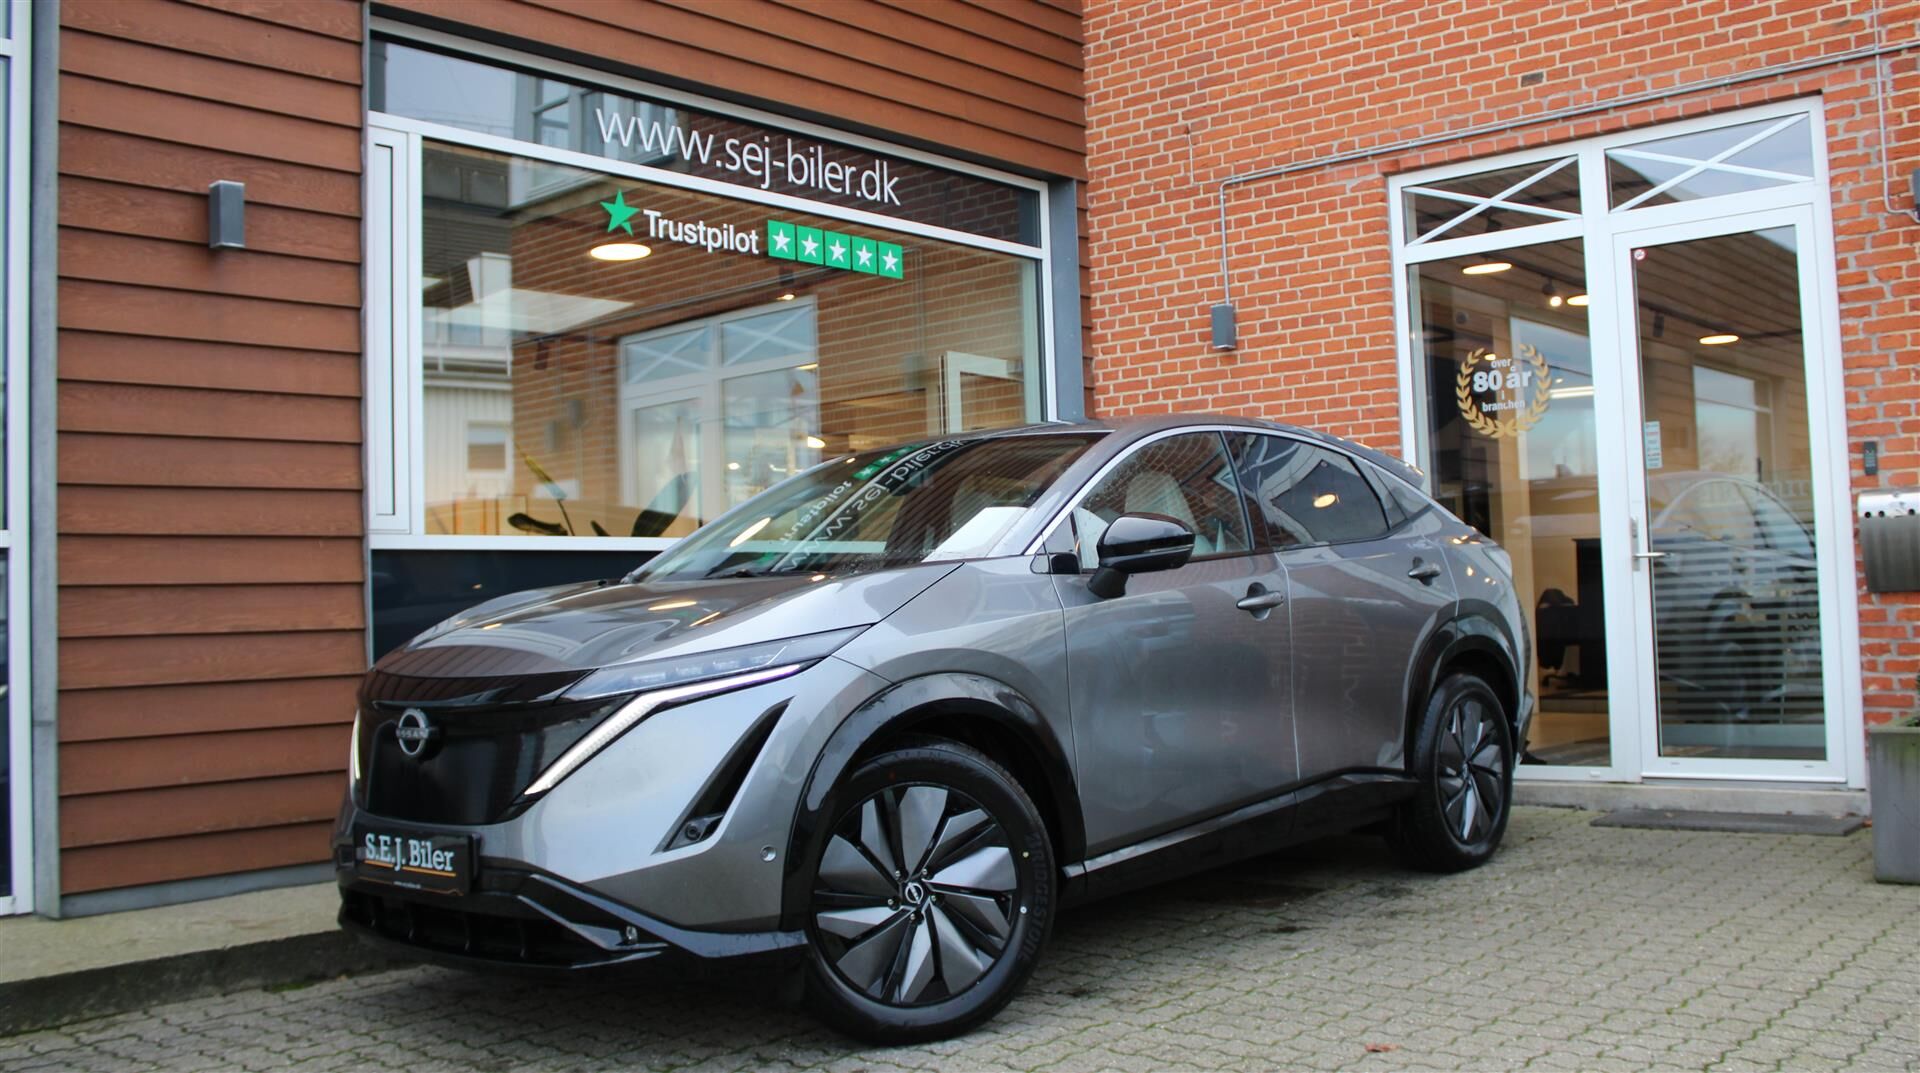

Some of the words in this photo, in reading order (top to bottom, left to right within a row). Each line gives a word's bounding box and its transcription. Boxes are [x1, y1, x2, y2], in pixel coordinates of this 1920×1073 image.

[595, 108, 901, 206] www.sej-biler.dk
[643, 209, 759, 254] Trustpilot
[1473, 370, 1502, 392] 80
[1506, 366, 1531, 388] år
[1491, 359, 1512, 368] over
[1482, 400, 1525, 412] branchen
[365, 833, 406, 871] S.E.J.
[408, 839, 454, 872] Biler
